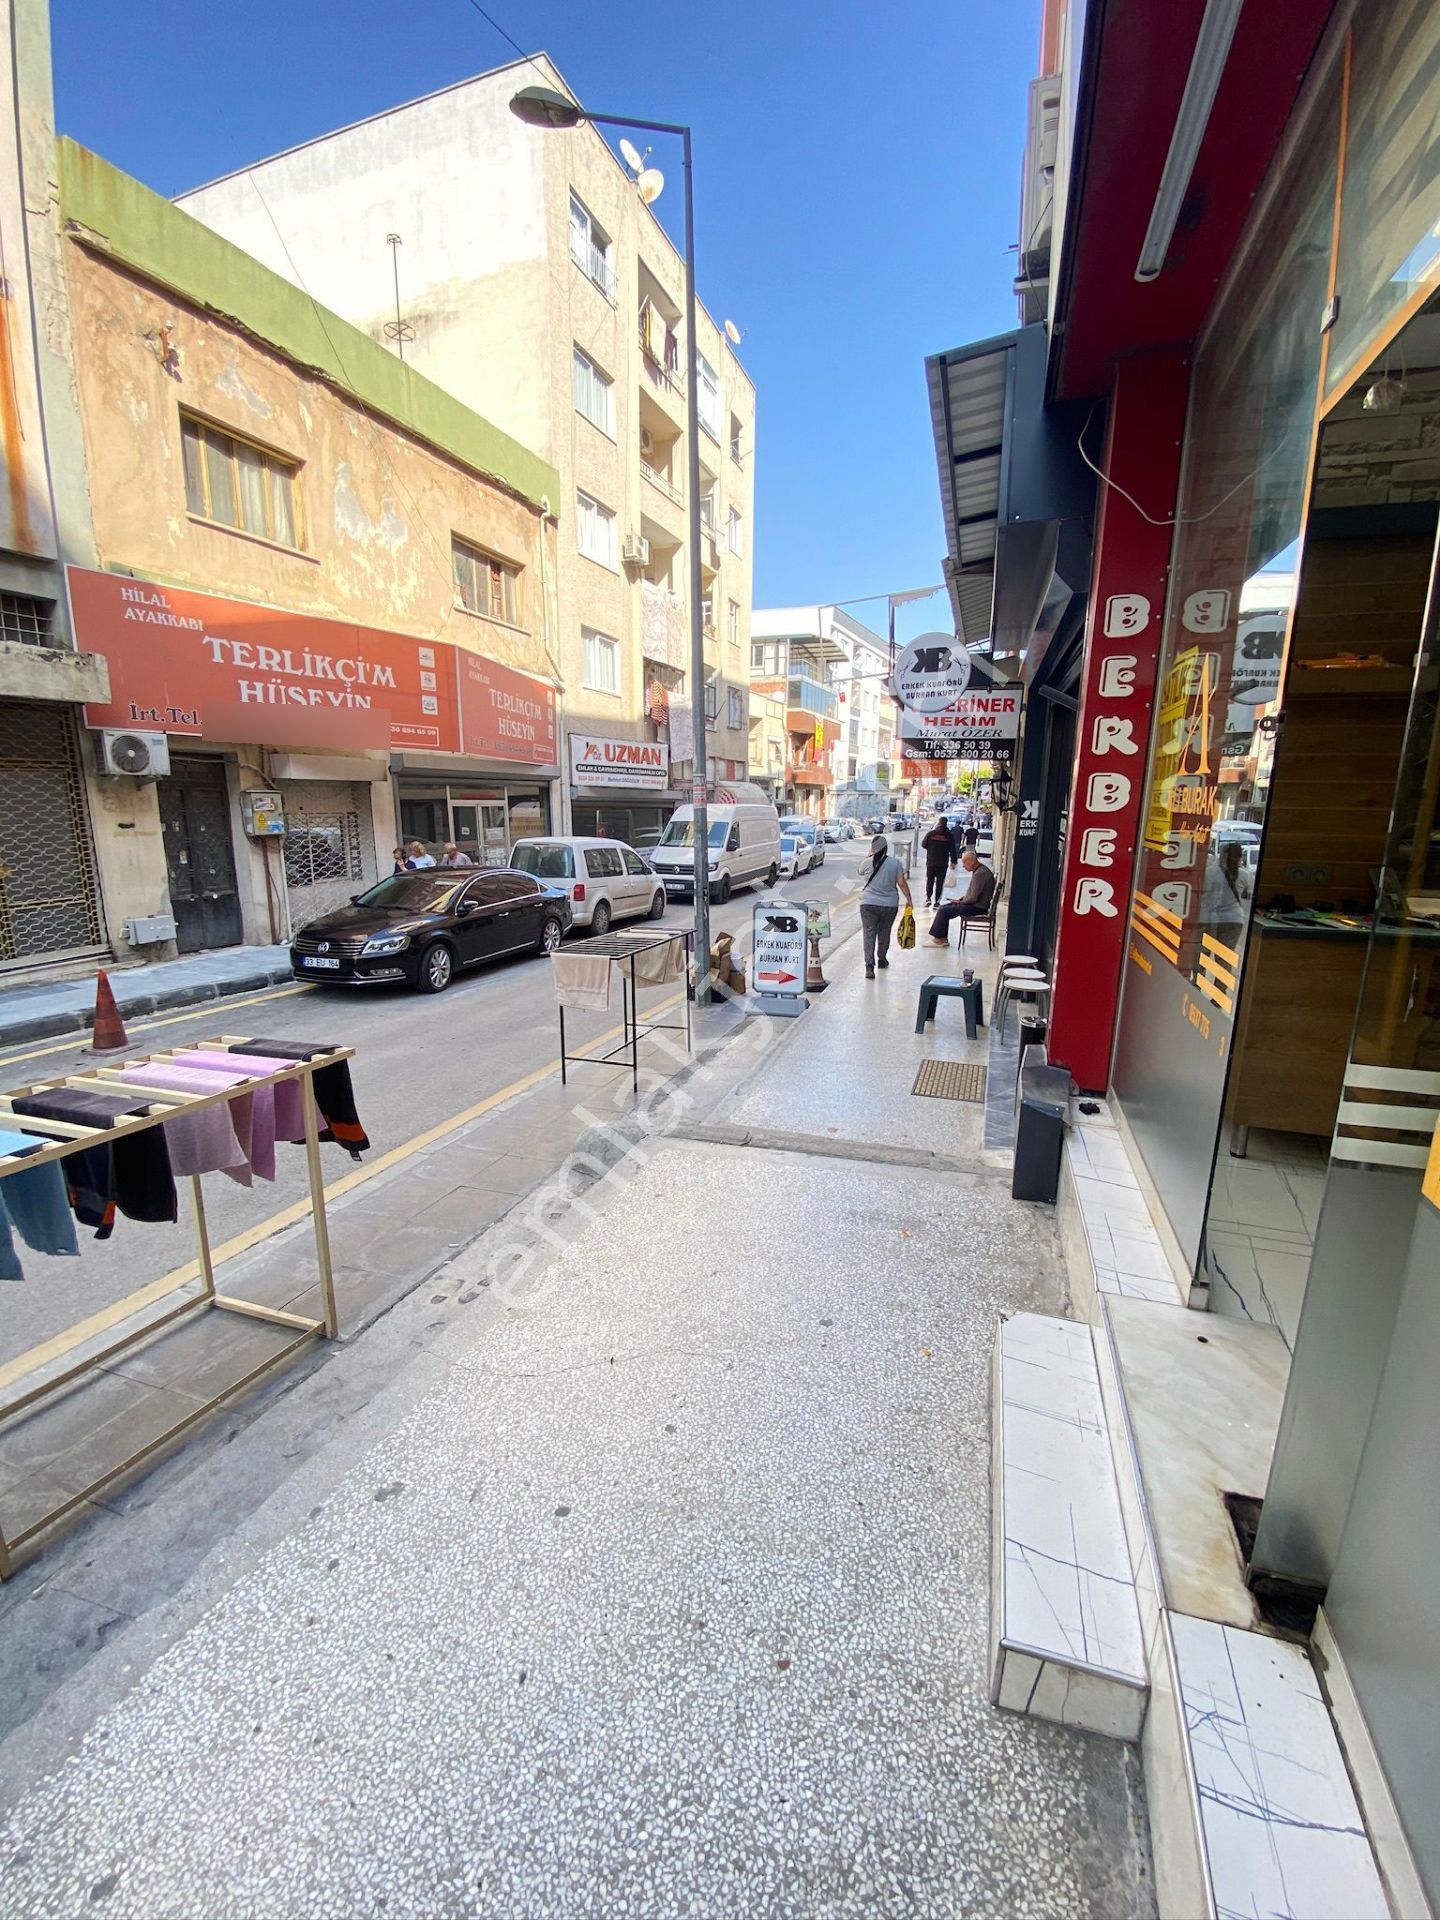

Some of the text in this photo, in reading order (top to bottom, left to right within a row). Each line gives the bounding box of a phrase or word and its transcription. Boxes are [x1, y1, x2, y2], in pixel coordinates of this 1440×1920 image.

[121, 587, 171, 609] HİLAL
[124, 606, 204, 632] AYAKKABI
[202, 634, 397, 688] TERLİKÇİ'M
[902, 679, 925, 690] ERKEK
[937, 688, 958, 697] KURT
[924, 714, 997, 727] HEKİM
[915, 726, 1003, 738] Murat ÖZER
[943, 740, 961, 750] 336
[964, 740, 976, 749] 50
[979, 740, 991, 749] 39
[604, 744, 661, 765] UZMAN
[905, 749, 1010, 760] Gsm: 0532 300 20 66
[756, 939, 775, 949] ERKEK
[759, 953, 783, 964] BURHAN
